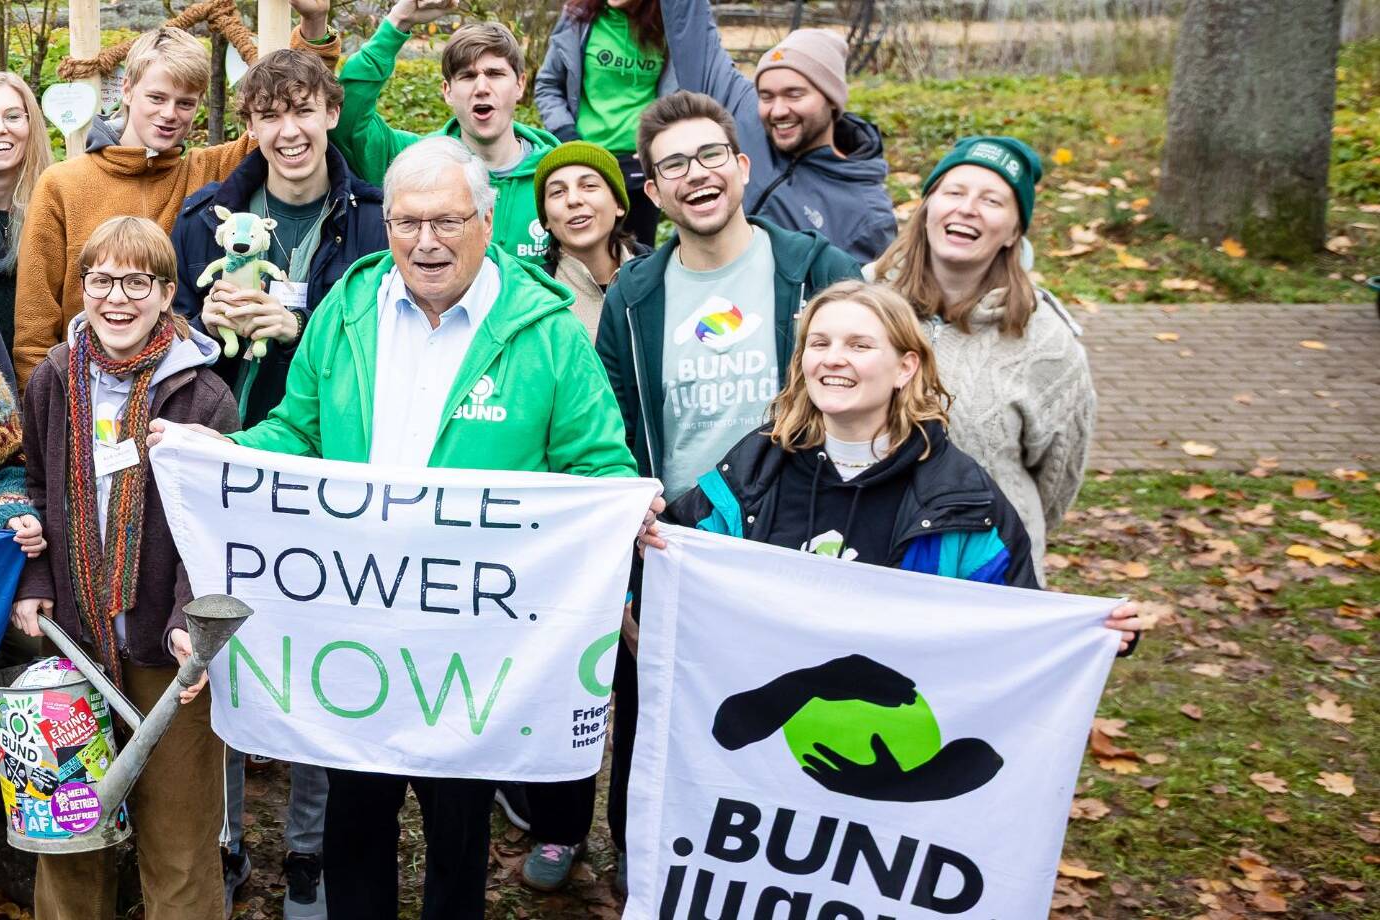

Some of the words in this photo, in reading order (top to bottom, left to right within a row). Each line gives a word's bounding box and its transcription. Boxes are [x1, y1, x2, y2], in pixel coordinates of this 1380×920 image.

[614, 56, 656, 71] BUND
[678, 350, 766, 383] BUND
[668, 367, 778, 417] jugend
[222, 462, 539, 529] PEOPLE.
[226, 541, 538, 622] POWER.
[227, 634, 533, 737] NOW.
[49, 712, 87, 739] EATING
[573, 702, 610, 722] Frien
[51, 716, 96, 751] ANIMALS
[572, 722, 600, 736] the
[2, 733, 38, 763] BUND
[67, 787, 90, 798] MEIN
[69, 797, 99, 811] BETRIEB
[24, 799, 51, 817] FC
[704, 797, 984, 914] BUND
